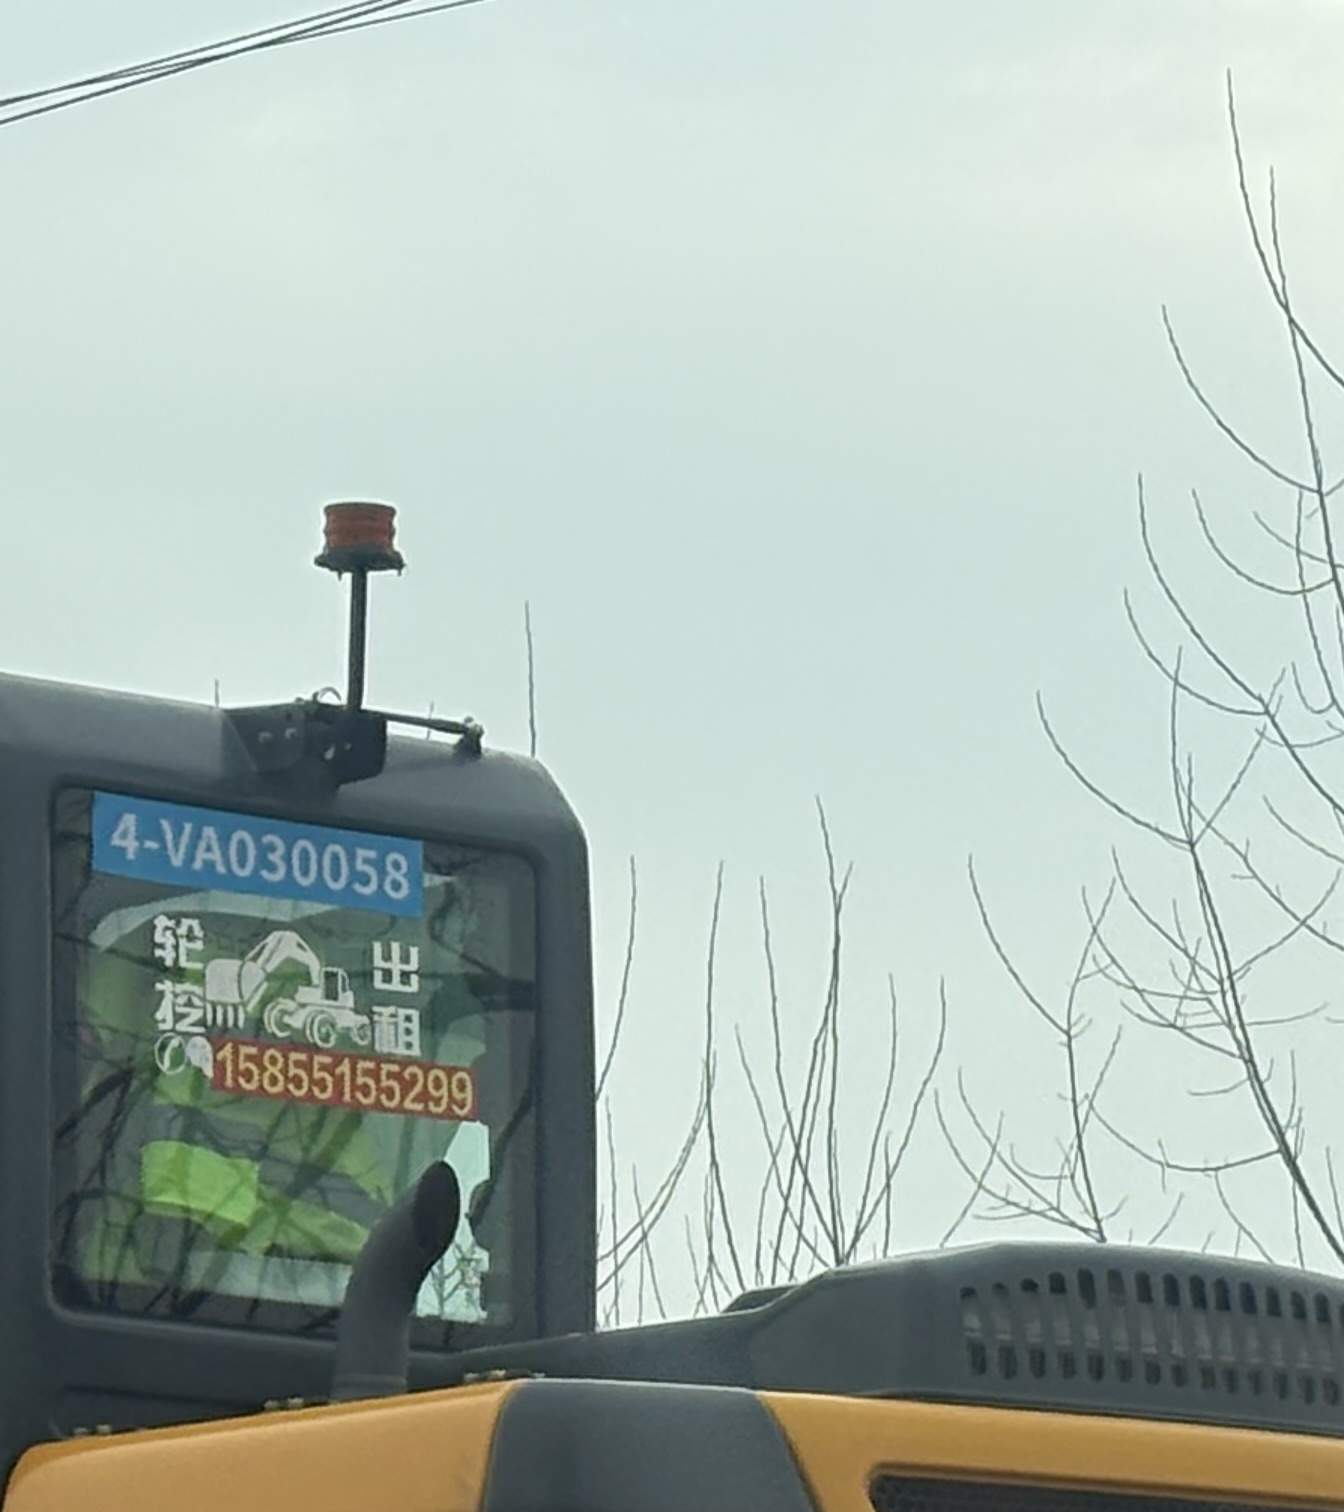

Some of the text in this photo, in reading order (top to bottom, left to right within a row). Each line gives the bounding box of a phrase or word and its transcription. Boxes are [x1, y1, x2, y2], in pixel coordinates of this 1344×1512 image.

[110, 811, 411, 900] 4-VA030058
[371, 940, 423, 1057] 出租
[215, 1041, 474, 1116] 15855155299
